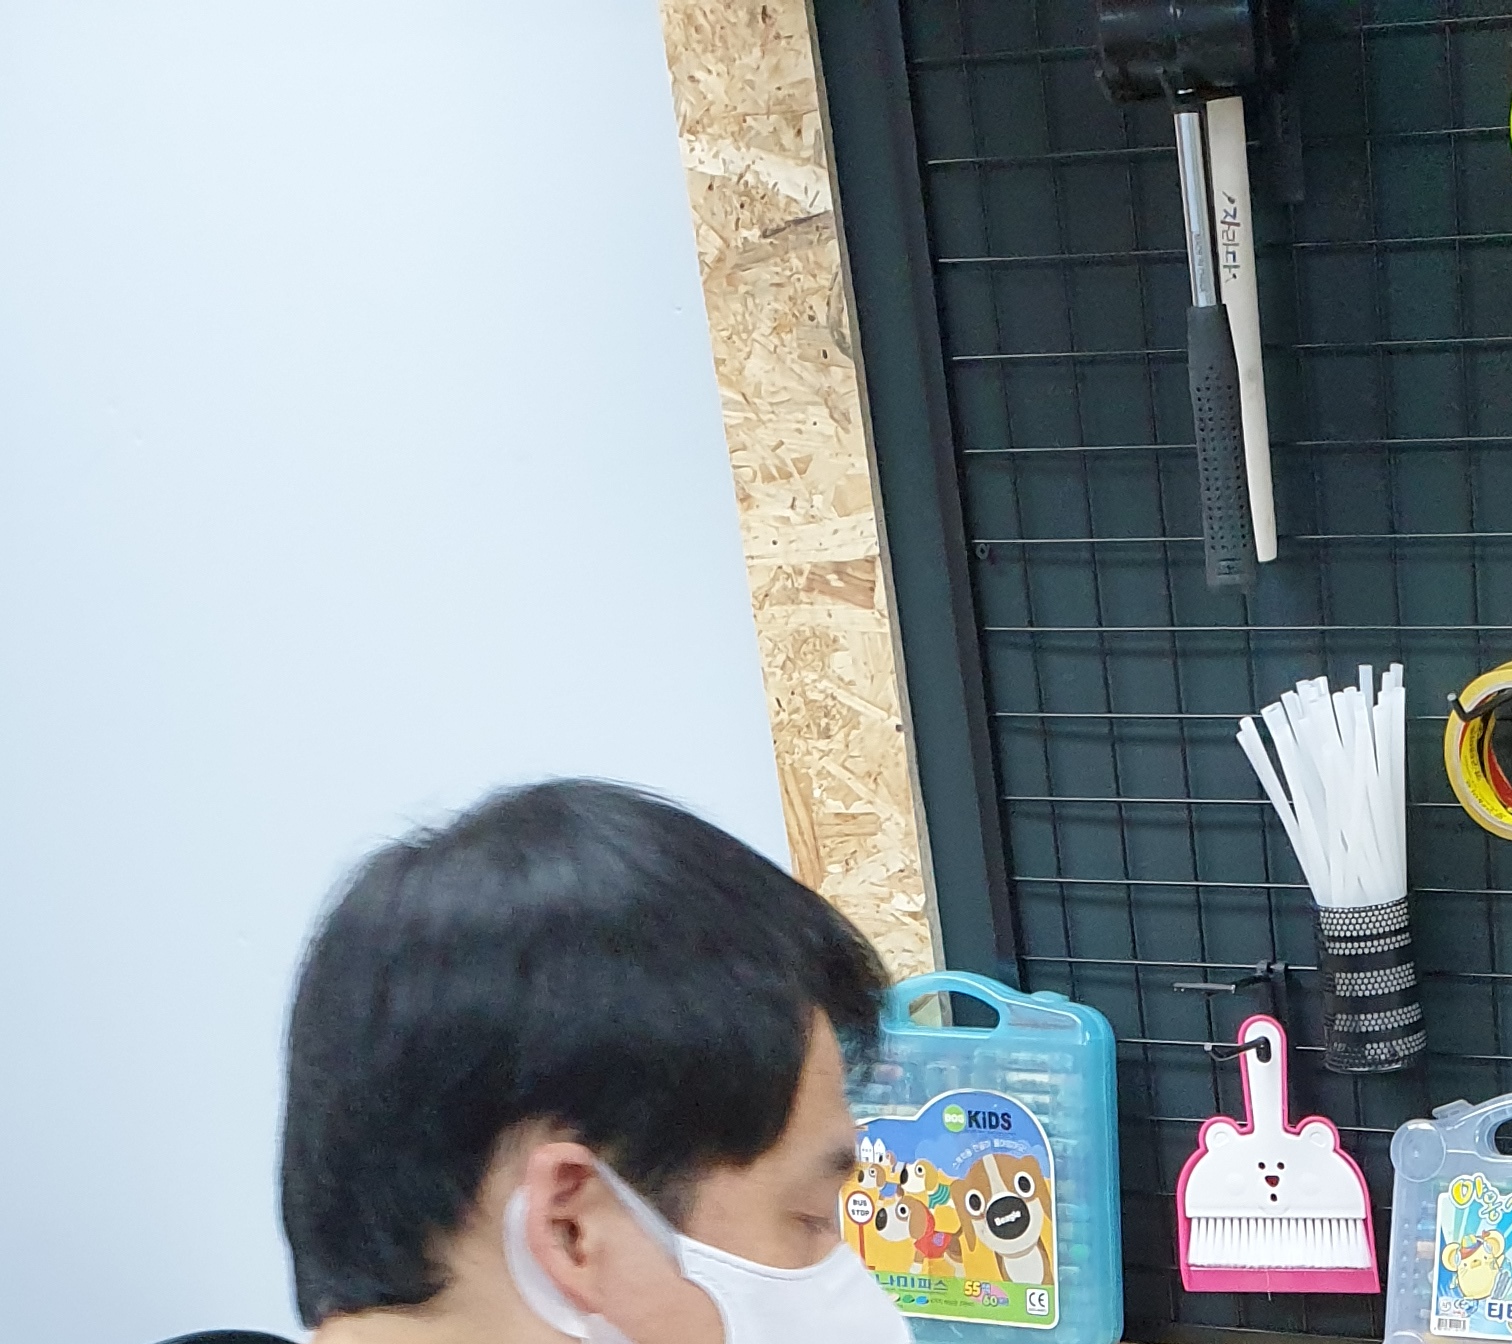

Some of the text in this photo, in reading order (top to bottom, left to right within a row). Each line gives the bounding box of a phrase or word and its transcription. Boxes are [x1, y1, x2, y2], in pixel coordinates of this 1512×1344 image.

[967, 1110, 1012, 1131] KIDS
[852, 1199, 868, 1207] BUS
[851, 1209, 870, 1217] STOP
